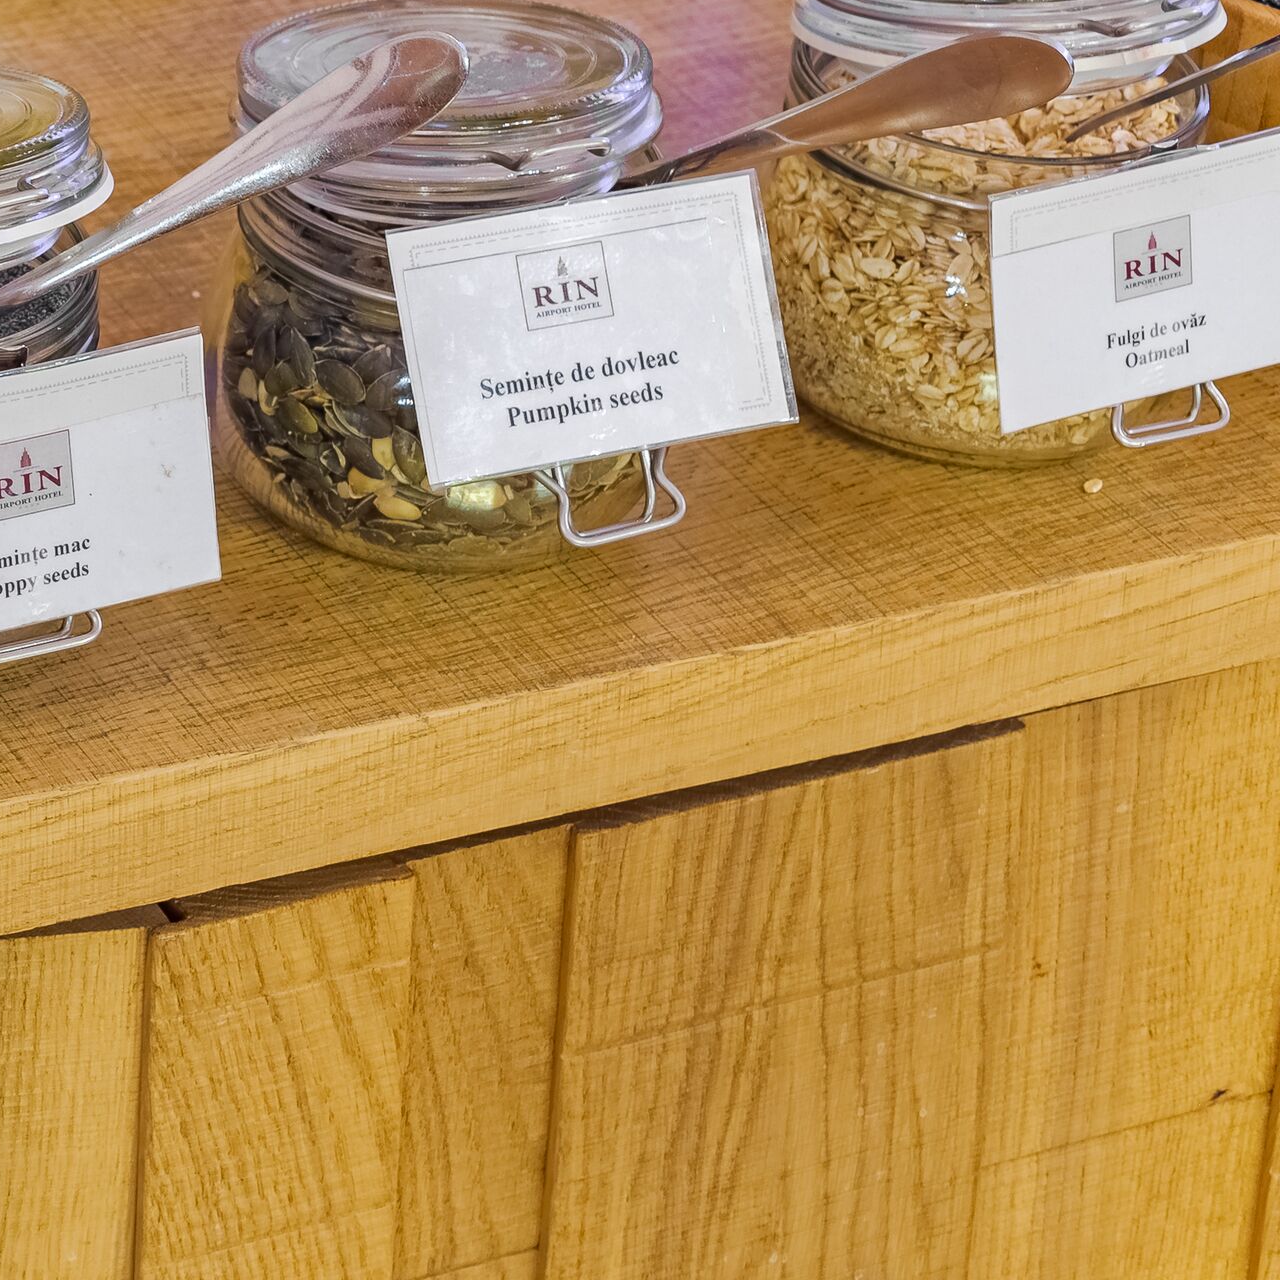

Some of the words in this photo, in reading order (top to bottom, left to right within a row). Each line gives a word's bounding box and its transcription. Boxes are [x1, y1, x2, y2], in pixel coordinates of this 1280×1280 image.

[1124, 248, 1183, 280] RIN
[532, 277, 601, 308] RIN
[1124, 276, 1156, 290] AIRPORT
[1158, 271, 1182, 282] HOTEL
[536, 306, 572, 319] AIRPORT
[574, 301, 602, 313] HOTEL
[1106, 325, 1145, 349] Fulgi
[1150, 322, 1167, 337] de
[1172, 313, 1206, 332] ovăz
[1125, 339, 1190, 368] Oatmeal
[480, 368, 564, 400] Semințe
[571, 362, 596, 384] de
[601, 350, 680, 377] dovleac
[507, 393, 604, 427] Pumpkin
[610, 382, 664, 408] seeds
[35, 491, 63, 501] HOTEL
[54, 537, 91, 556] mac
[43, 563, 89, 585] seeds
